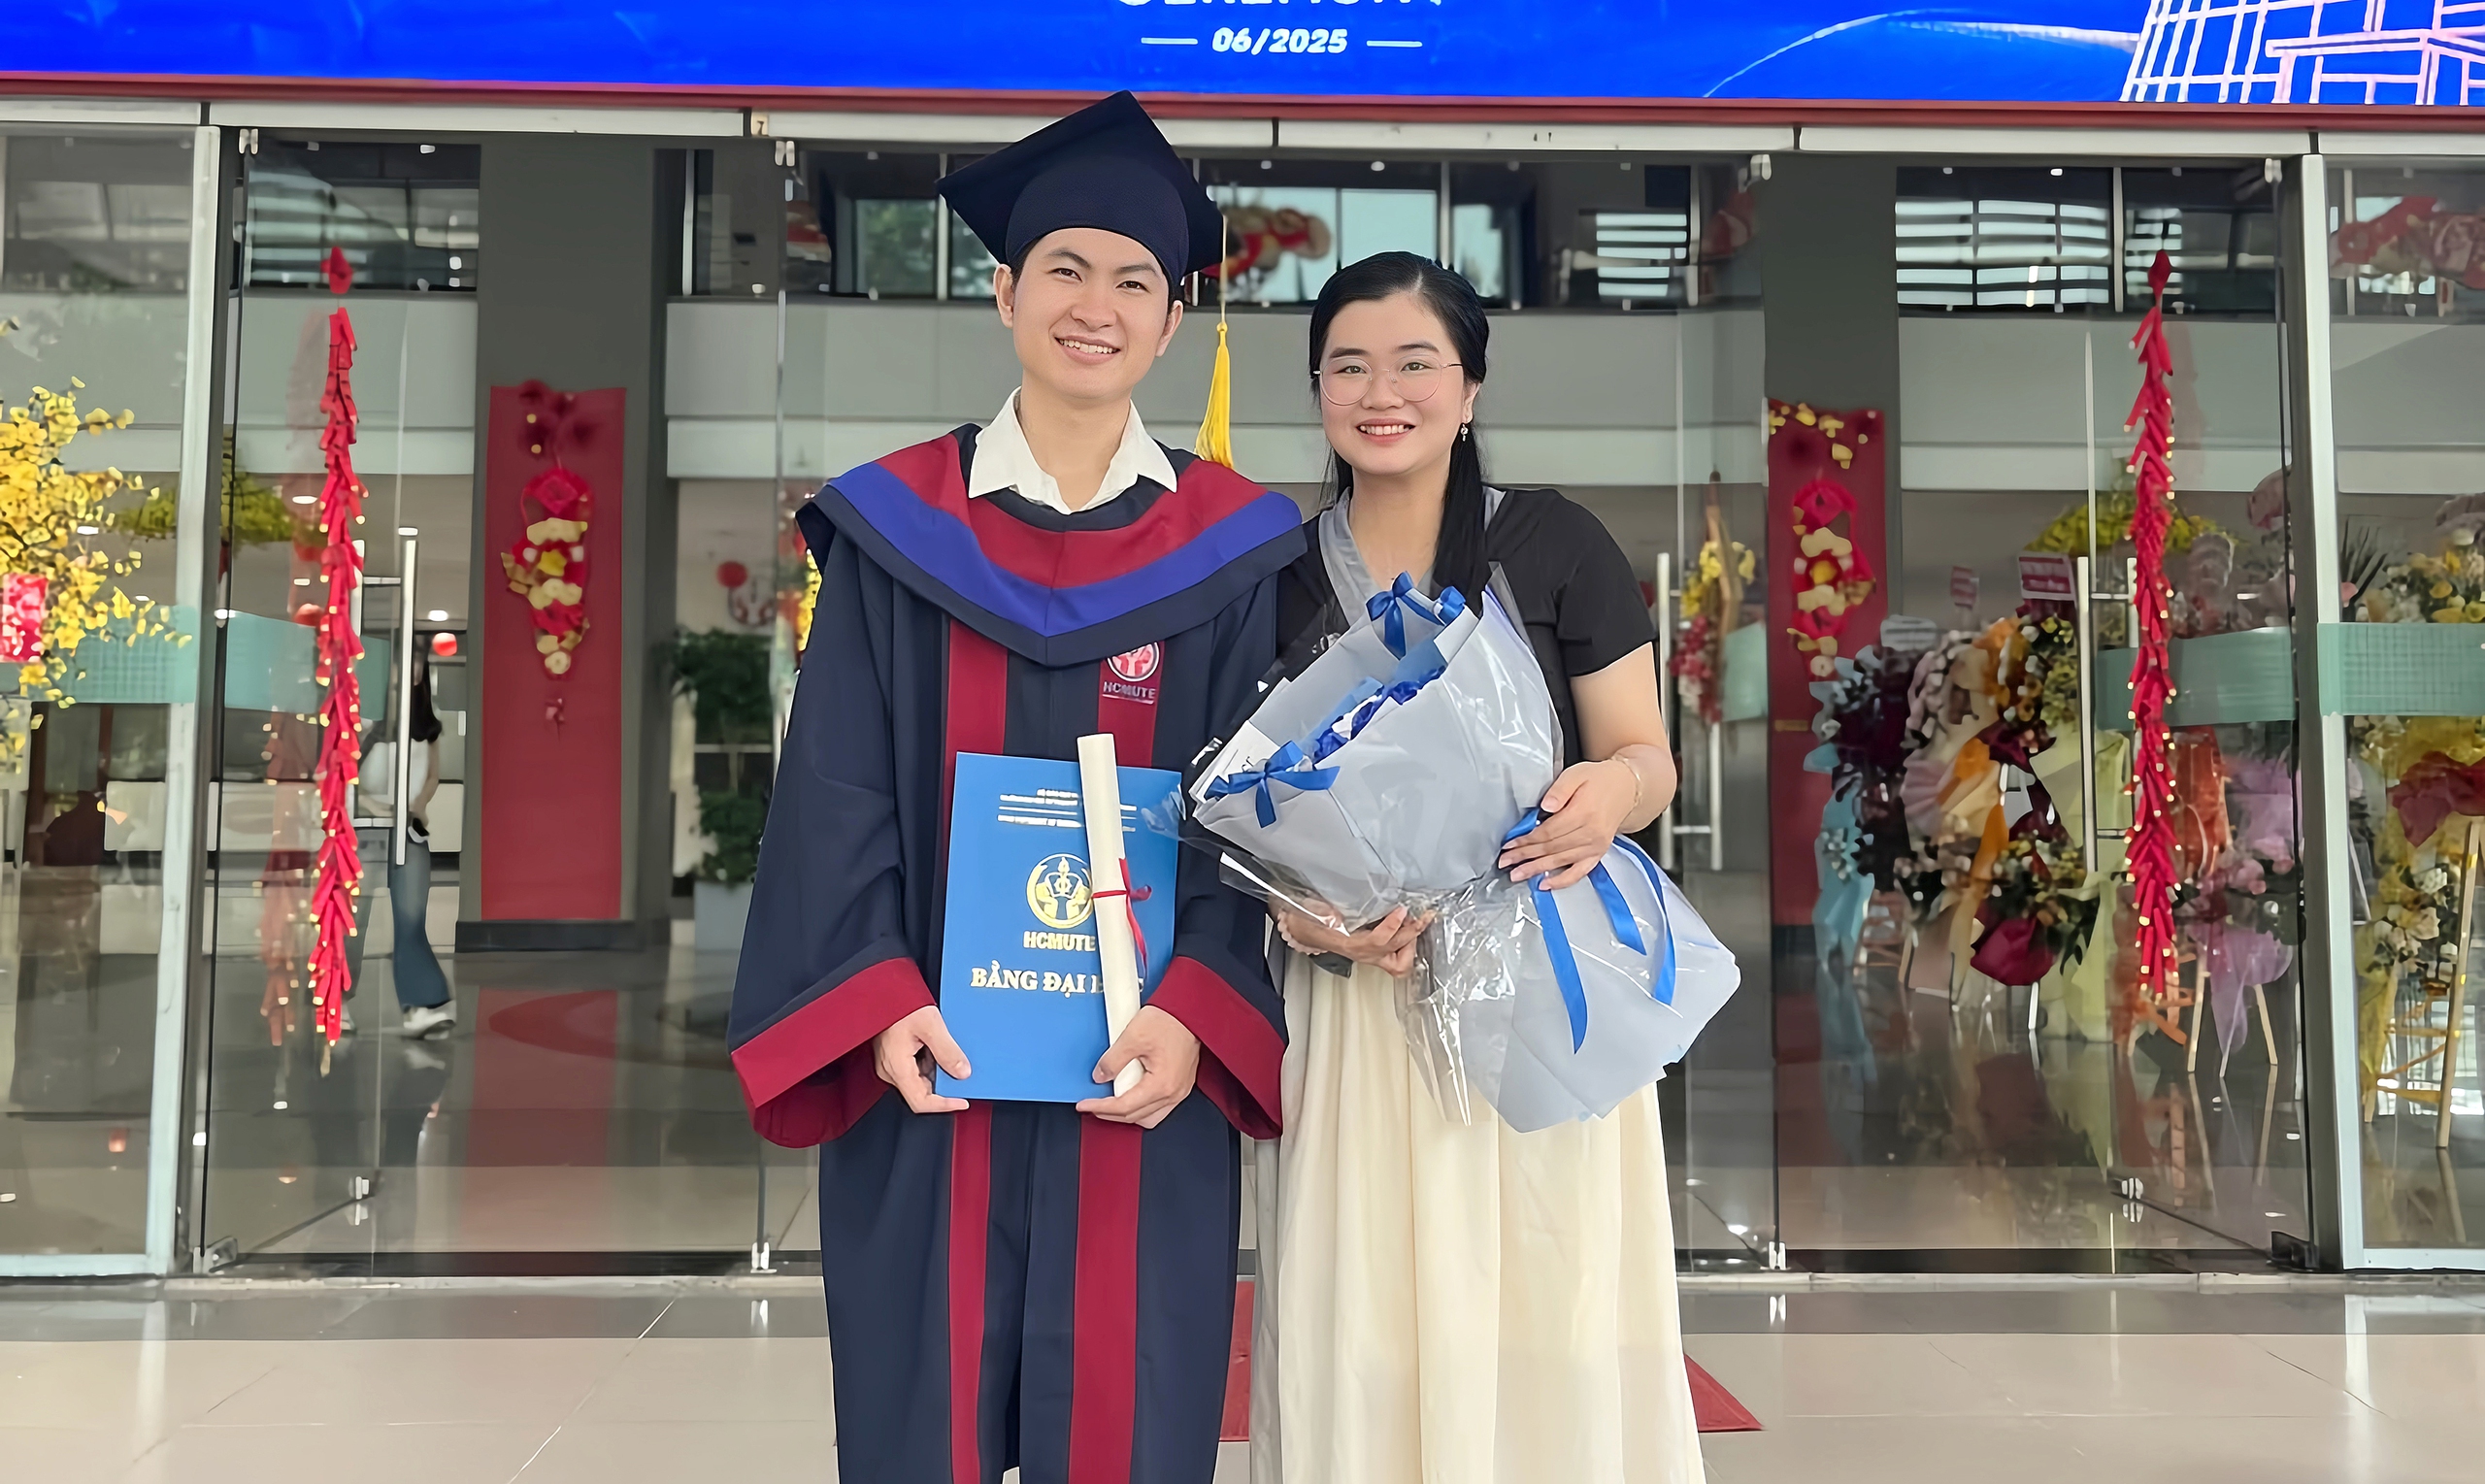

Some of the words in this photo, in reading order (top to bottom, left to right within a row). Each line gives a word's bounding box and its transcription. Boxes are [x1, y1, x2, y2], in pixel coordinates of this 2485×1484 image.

[1212, 27, 1348, 55] 06/2025
[1103, 681, 1156, 699] HCMUTE
[1023, 931, 1096, 951] HCMUTE
[970, 959, 1038, 990] BẢNG
[1043, 972, 1086, 998] ĐẠI
